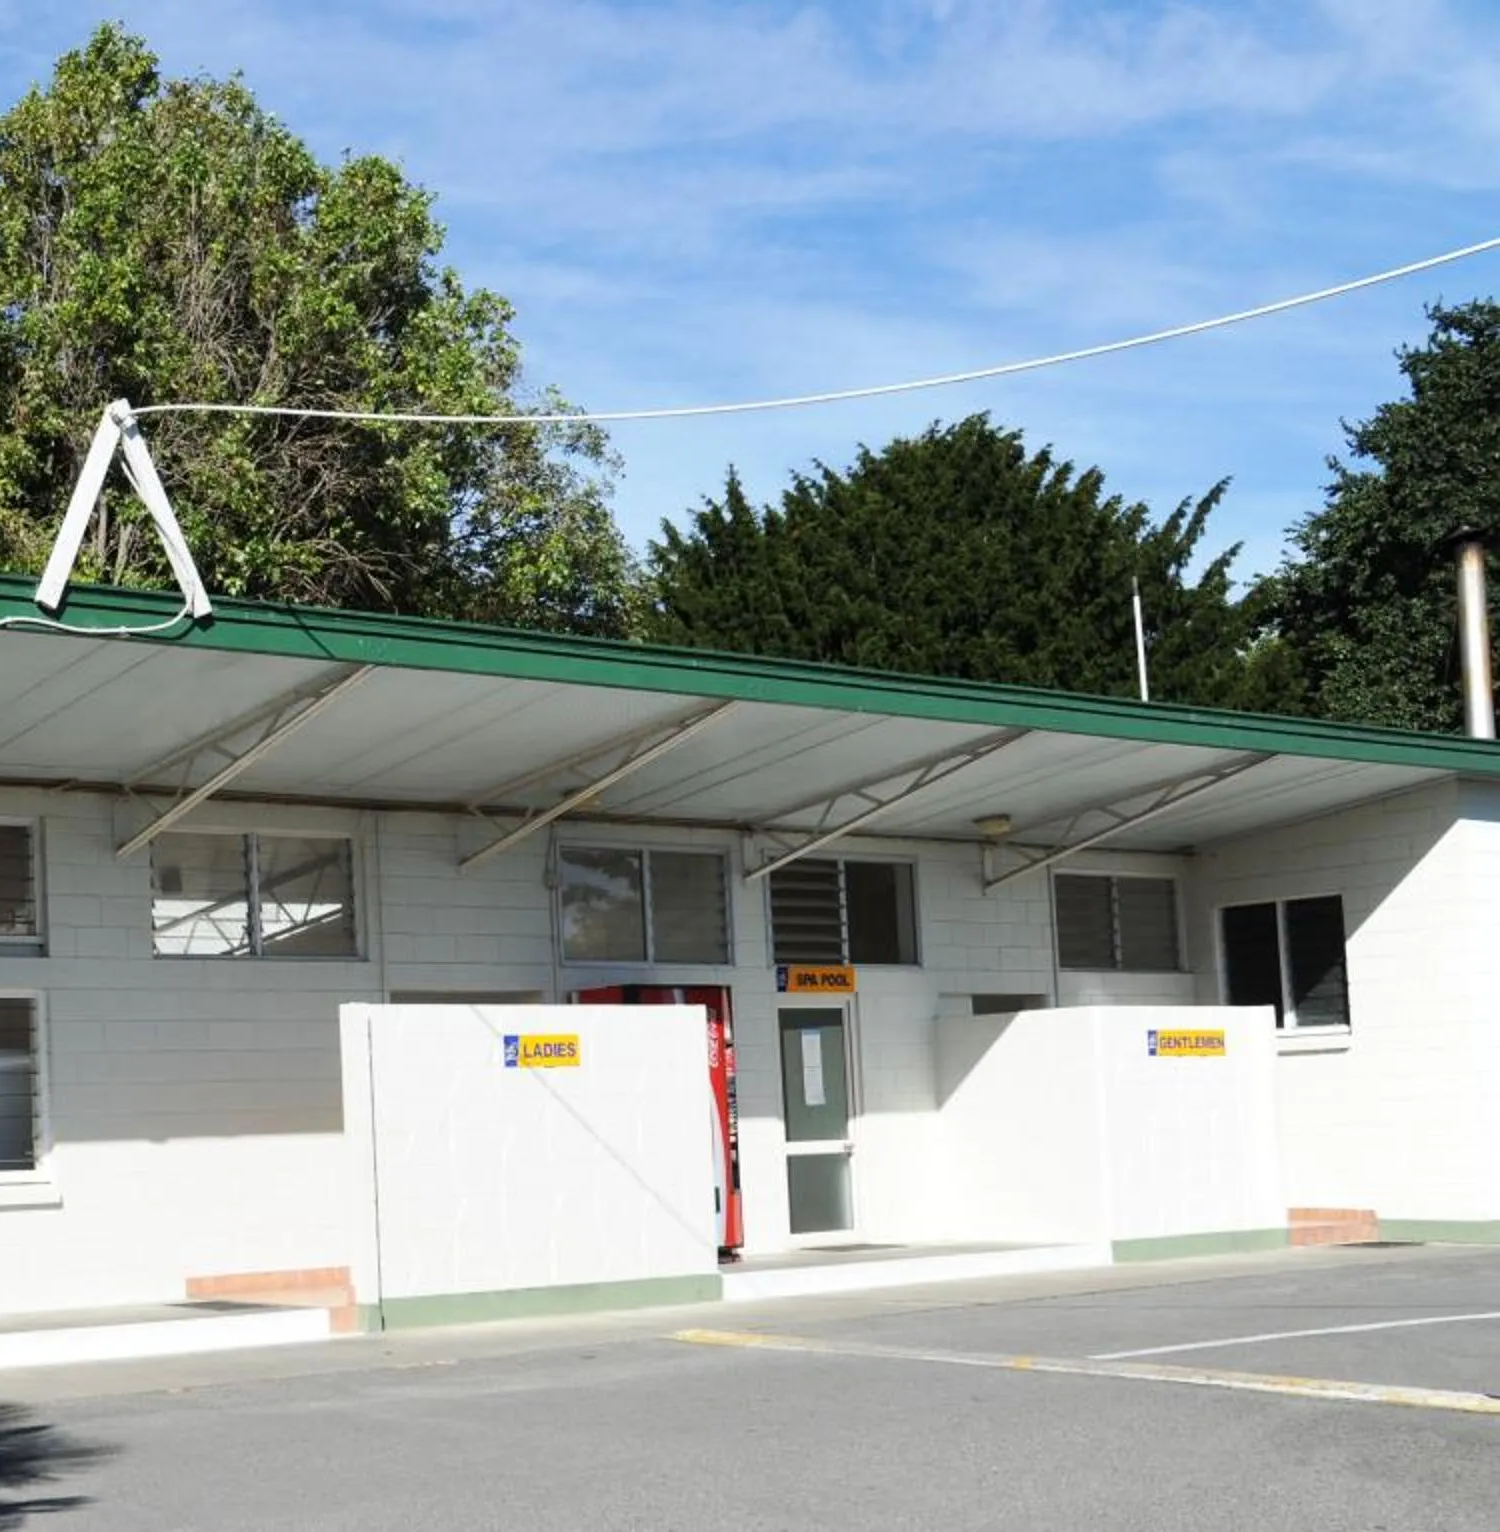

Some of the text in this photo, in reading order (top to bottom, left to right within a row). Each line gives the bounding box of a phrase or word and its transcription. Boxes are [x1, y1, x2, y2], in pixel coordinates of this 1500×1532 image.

[797, 974, 850, 987] SPA POOL
[1160, 1035, 1225, 1049] GENTLEMEN
[523, 1042, 577, 1058] LADIES
